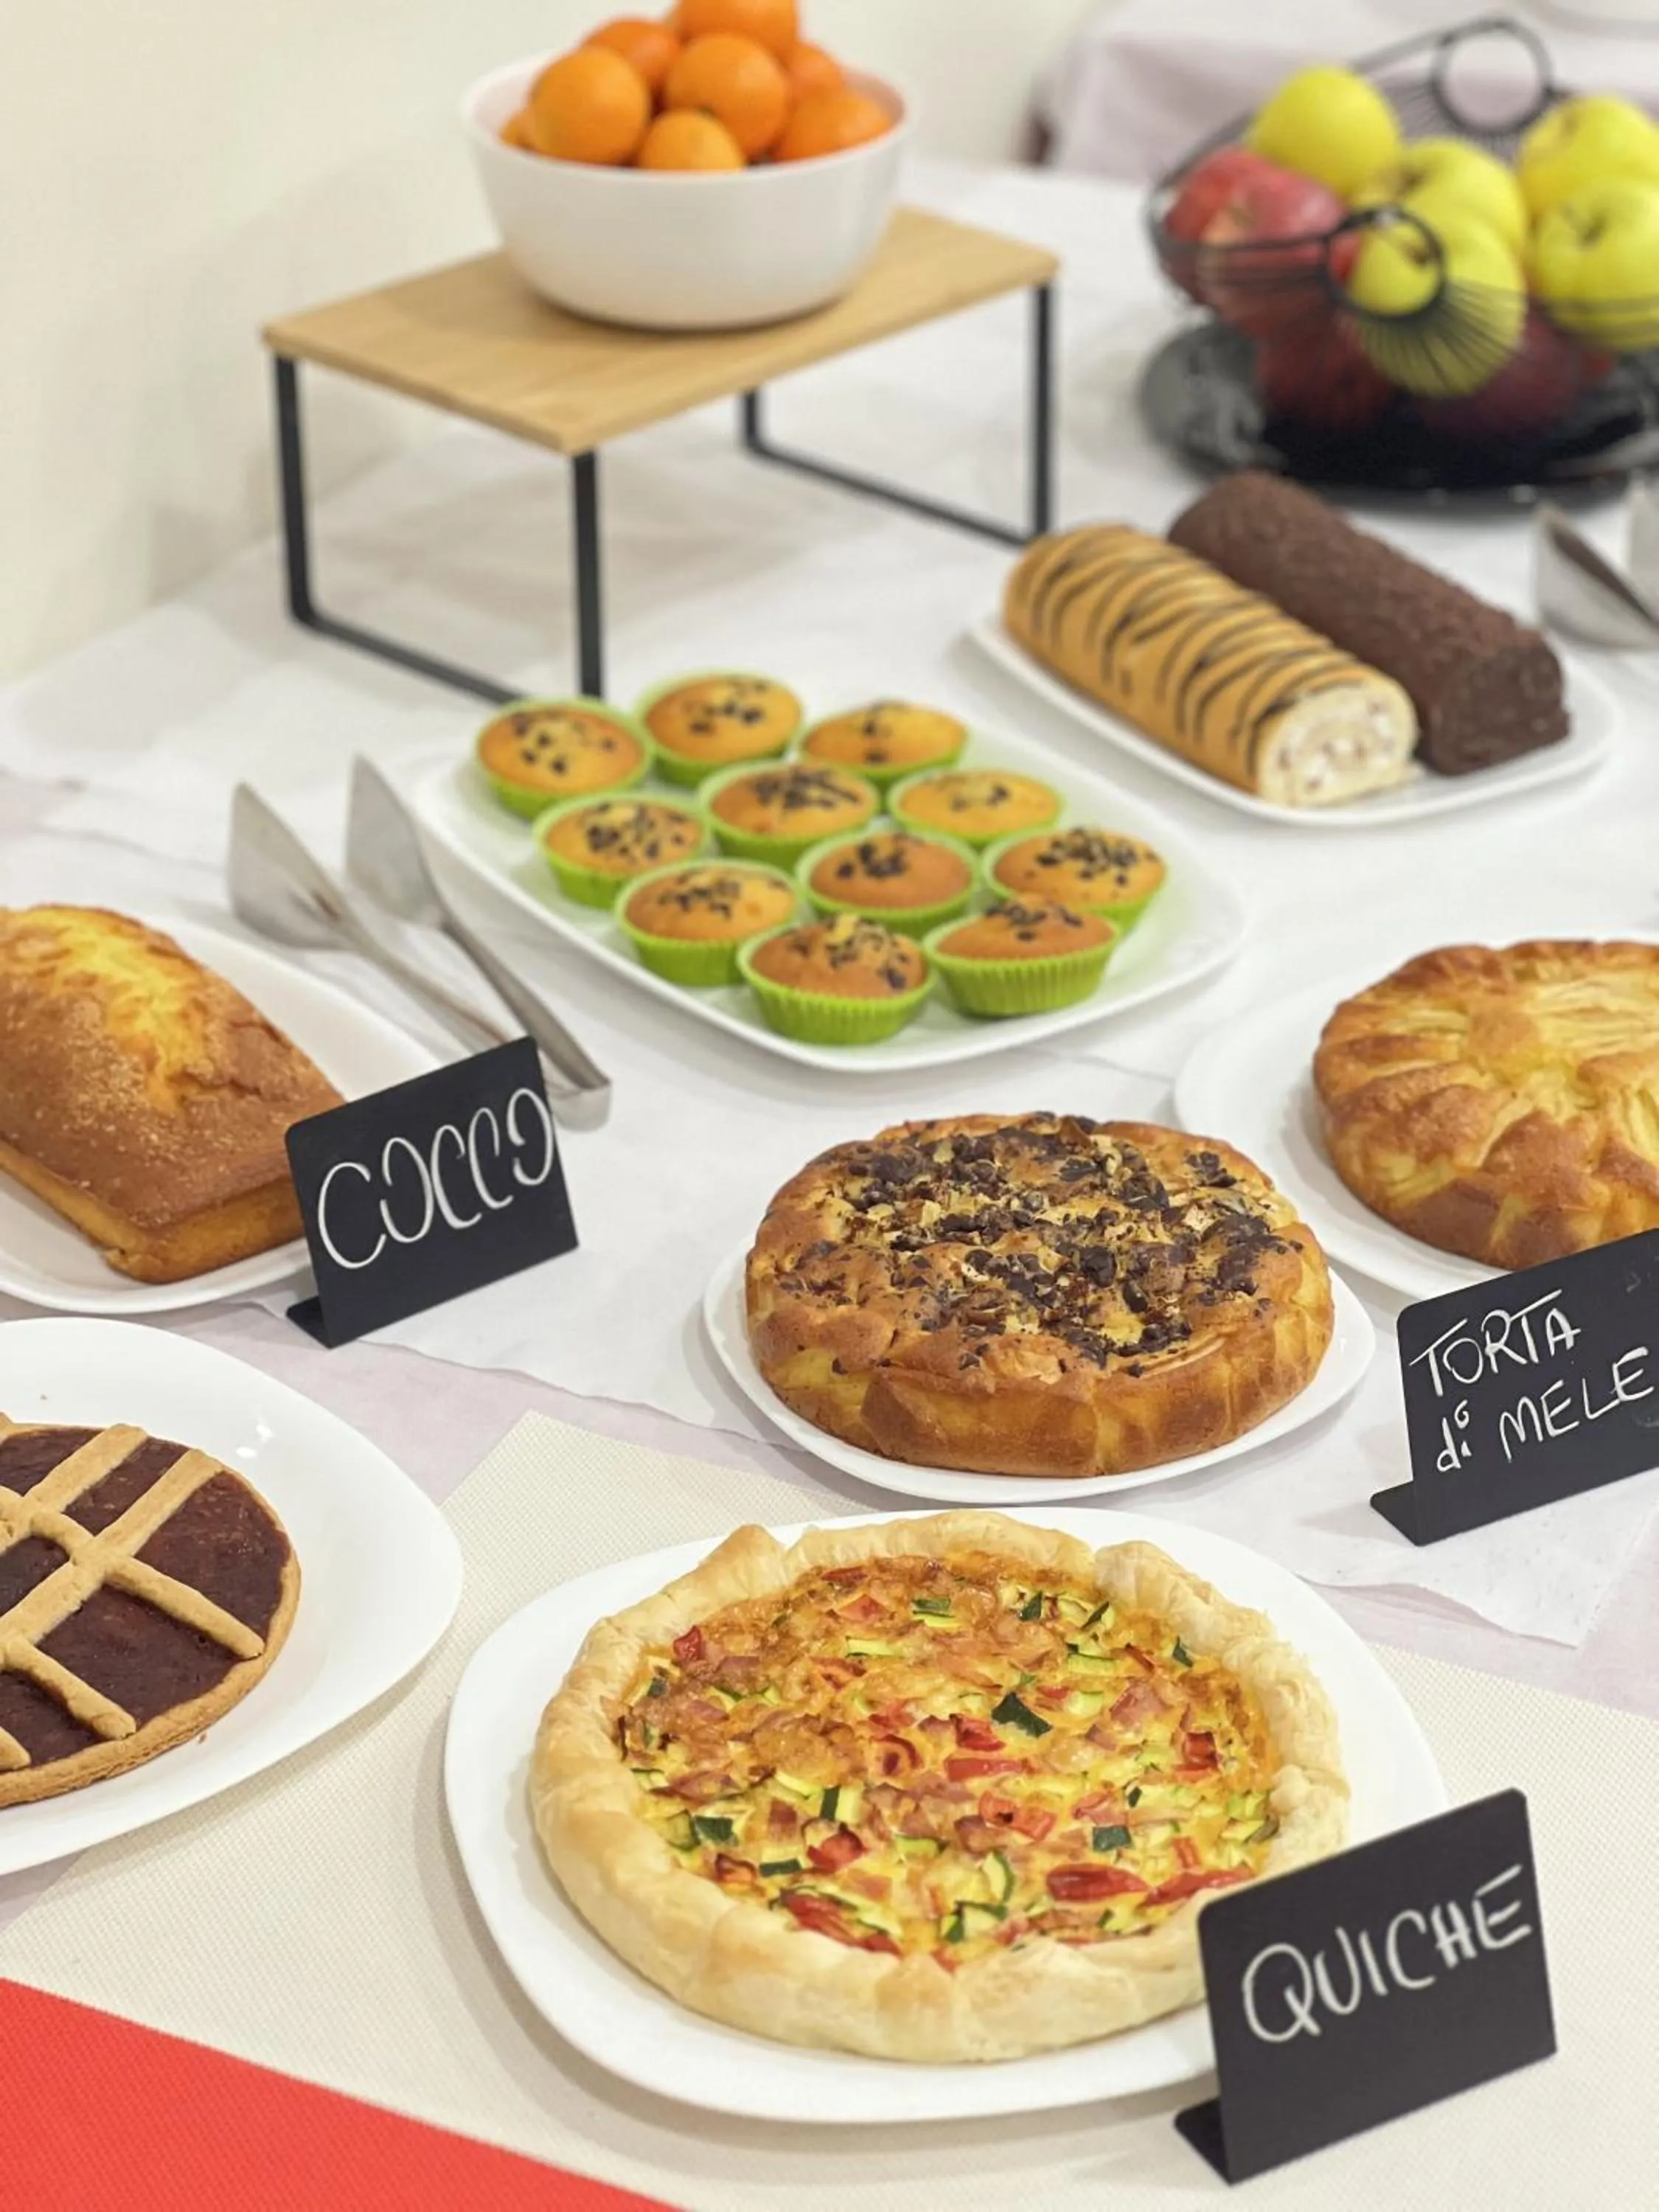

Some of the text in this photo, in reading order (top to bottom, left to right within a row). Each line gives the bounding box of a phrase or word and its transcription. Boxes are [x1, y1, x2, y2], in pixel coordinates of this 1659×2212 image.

[318, 1088, 554, 1270] COCCO
[1409, 1289, 1582, 1397] TORTA
[1436, 1346, 1655, 1472] di MELE
[1242, 1865, 1532, 2043] QUICHE
